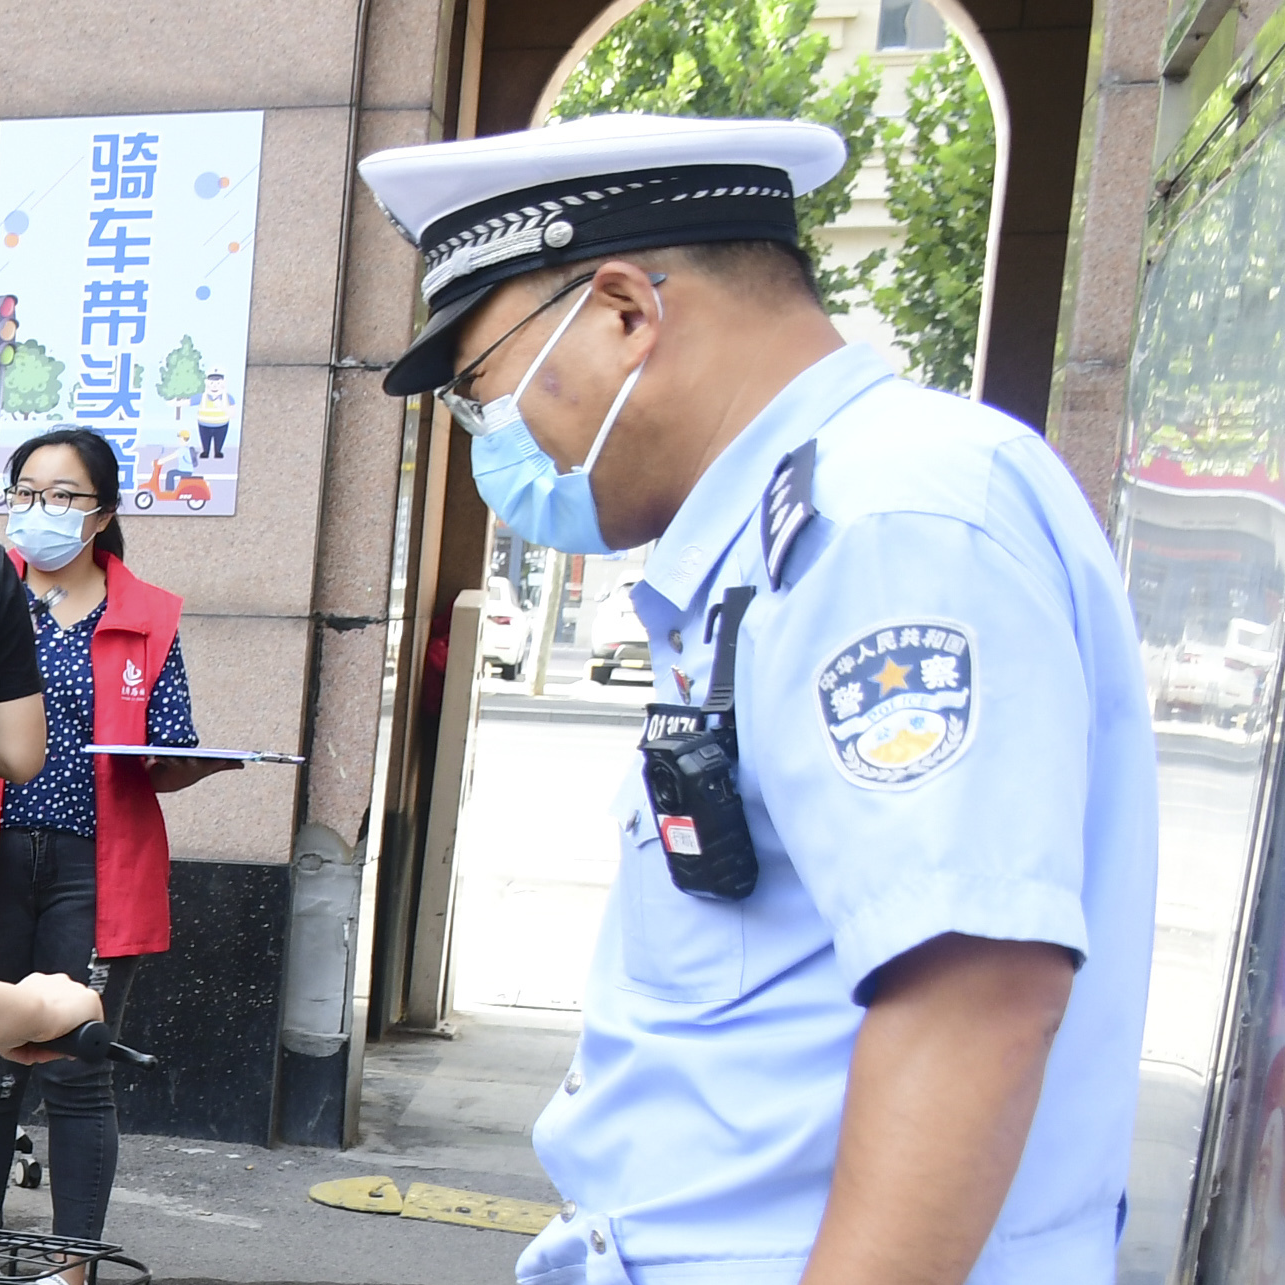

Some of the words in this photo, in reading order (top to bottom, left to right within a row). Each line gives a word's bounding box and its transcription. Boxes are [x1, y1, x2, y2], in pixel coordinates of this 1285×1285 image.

[819, 627, 968, 692] 中华人民共和国
